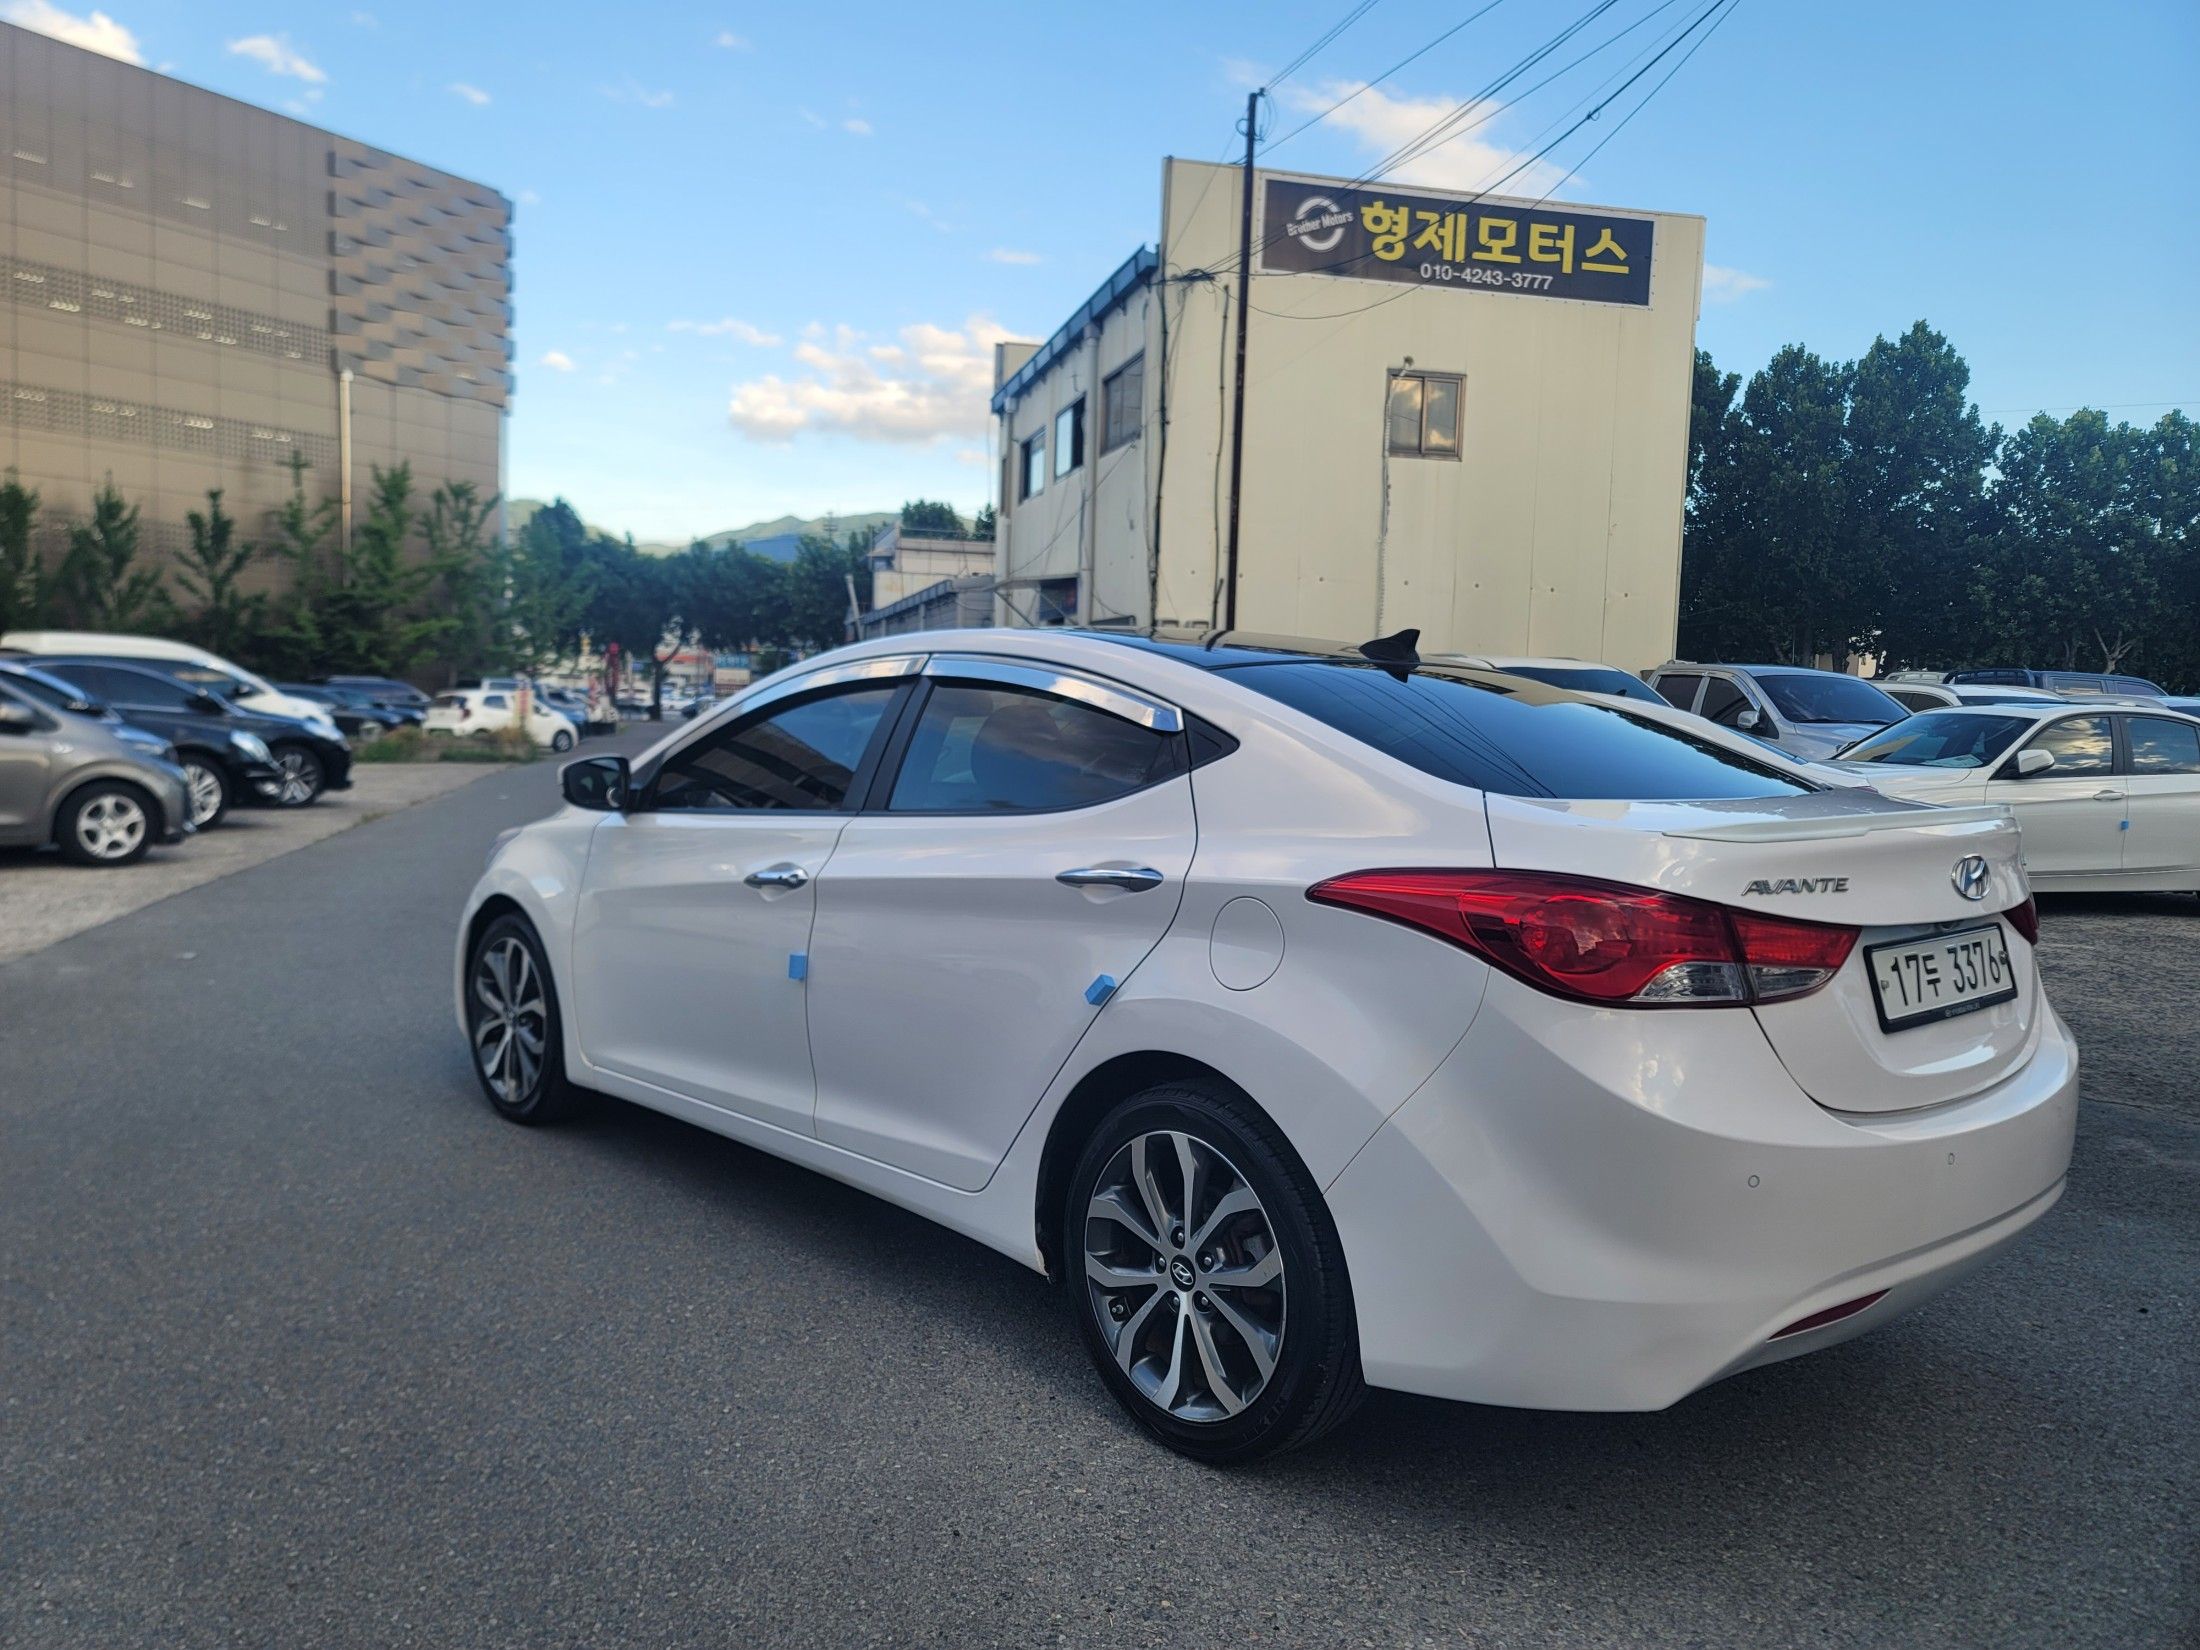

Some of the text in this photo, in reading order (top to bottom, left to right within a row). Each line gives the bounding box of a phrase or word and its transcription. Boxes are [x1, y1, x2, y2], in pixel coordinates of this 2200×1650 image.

[1321, 212, 1354, 229] Motors
[1360, 201, 1630, 274] 형제모터스
[1420, 263, 1553, 290] 010-4243-3777
[1741, 877, 1849, 896] AVANTE
[1946, 938, 2001, 993] 3376
